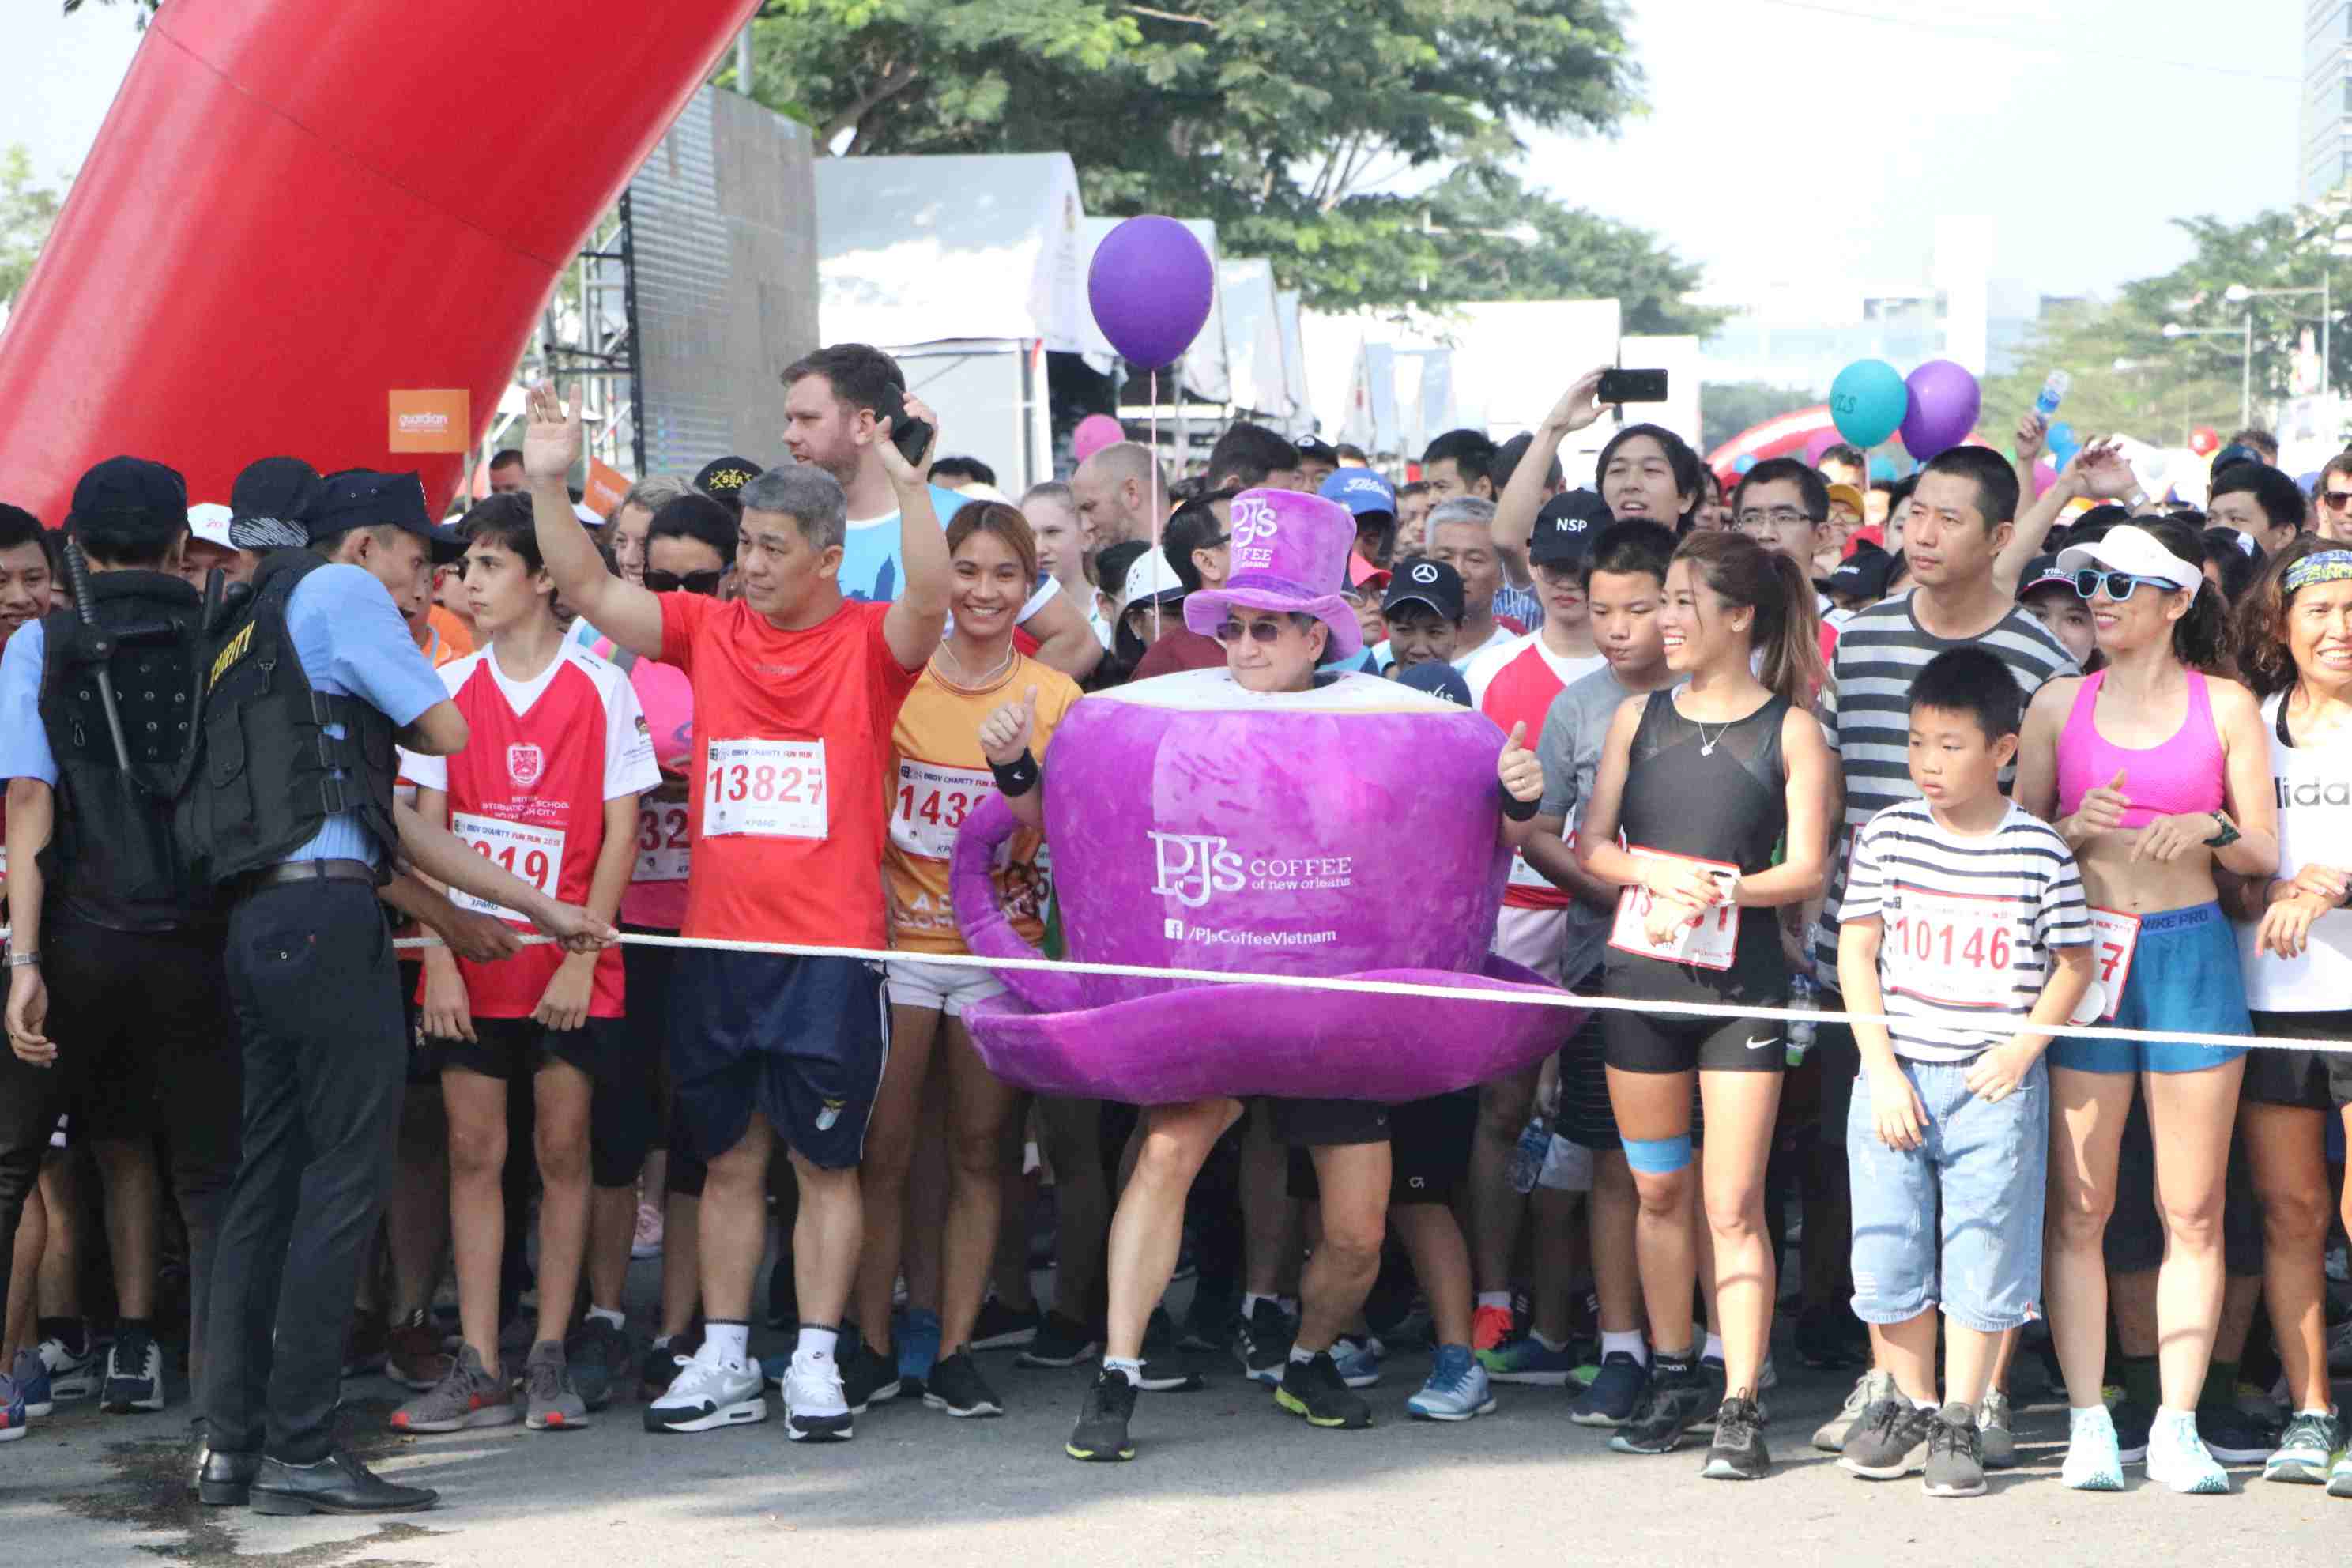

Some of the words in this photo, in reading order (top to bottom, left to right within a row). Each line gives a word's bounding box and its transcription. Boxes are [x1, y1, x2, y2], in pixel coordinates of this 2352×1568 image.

[1556, 518, 1588, 532] NSP
[709, 764, 824, 805] 13827
[537, 808, 557, 817] CITY
[899, 783, 988, 829] 143
[1250, 857, 1354, 877] COFFEE
[1251, 878, 1265, 891] of
[1268, 880, 1298, 891] new
[1300, 876, 1351, 889] orleans
[2142, 914, 2177, 932] NIKE
[2179, 909, 2210, 926] PRO
[1896, 915, 2011, 971] 10146
